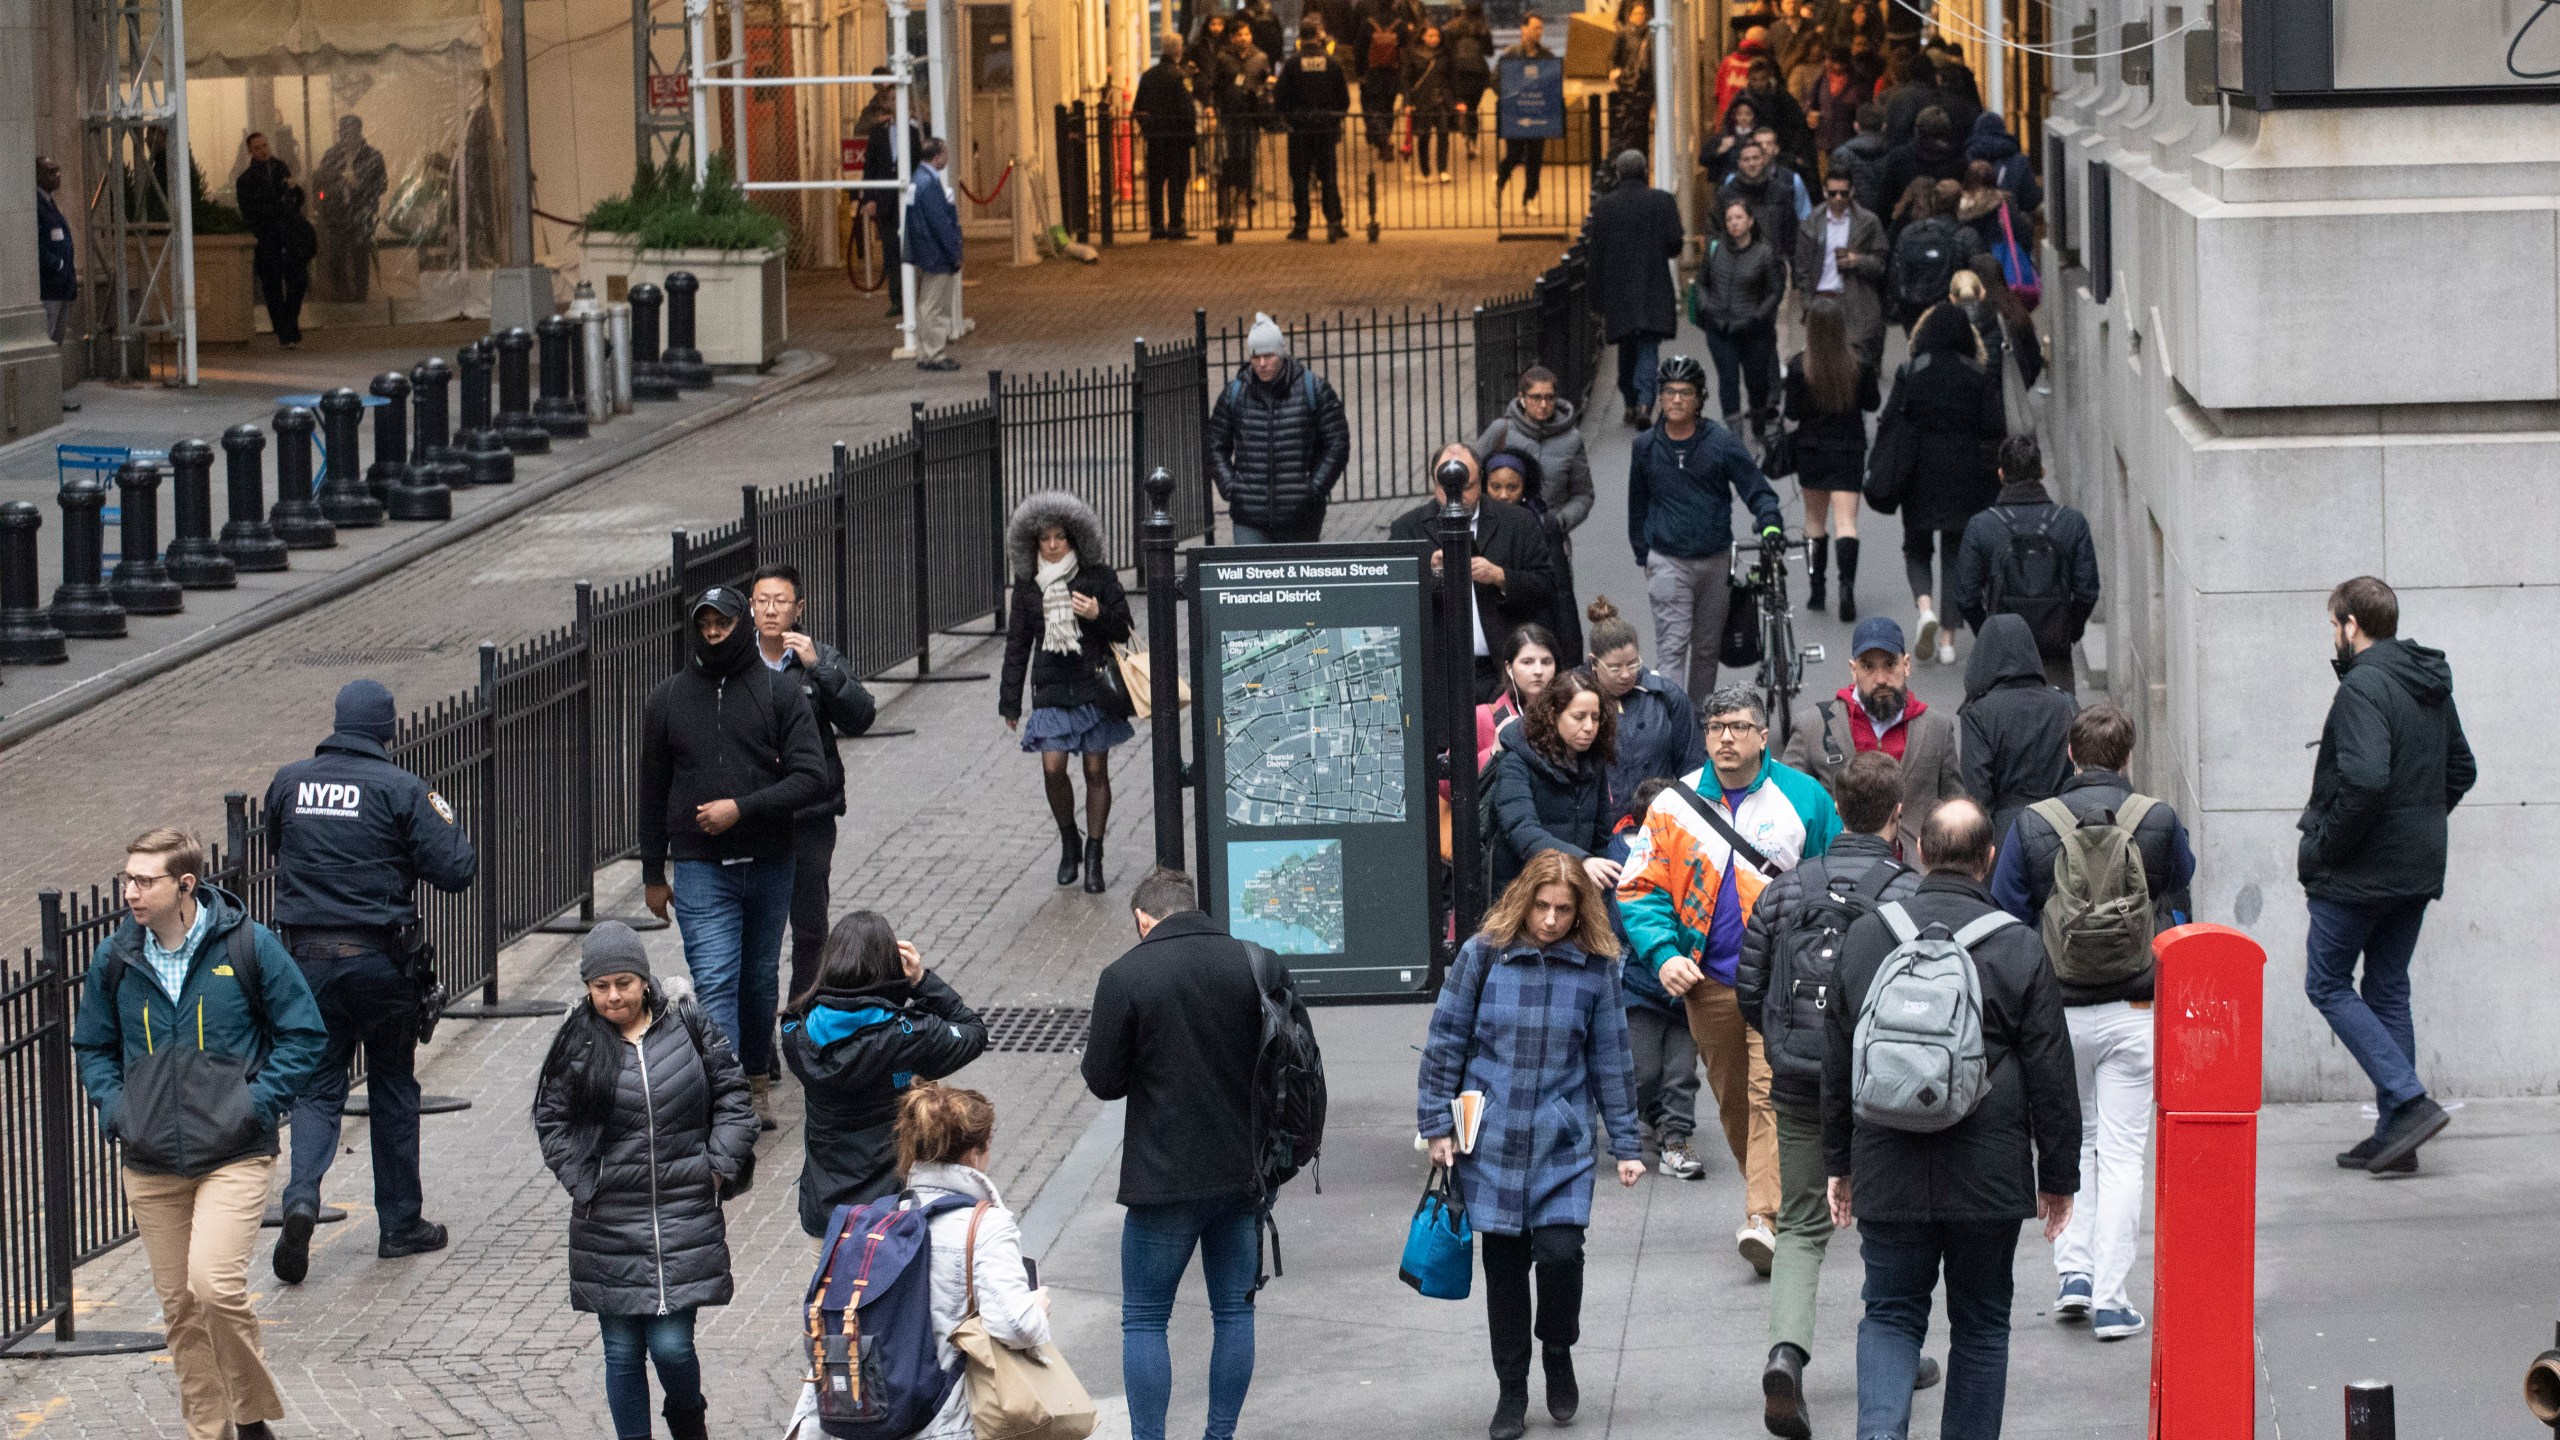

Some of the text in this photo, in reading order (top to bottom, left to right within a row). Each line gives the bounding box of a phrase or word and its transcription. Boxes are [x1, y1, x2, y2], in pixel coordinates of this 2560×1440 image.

[653, 77, 686, 94] EXI
[1217, 563, 1389, 580] Wall Street & Nassau Street
[1219, 590, 1321, 605] Financial District
[1229, 648, 1243, 656] City
[1266, 760, 1290, 768] District
[297, 782, 361, 809] NYPD
[295, 807, 359, 818] COUNTERTERRORISM
